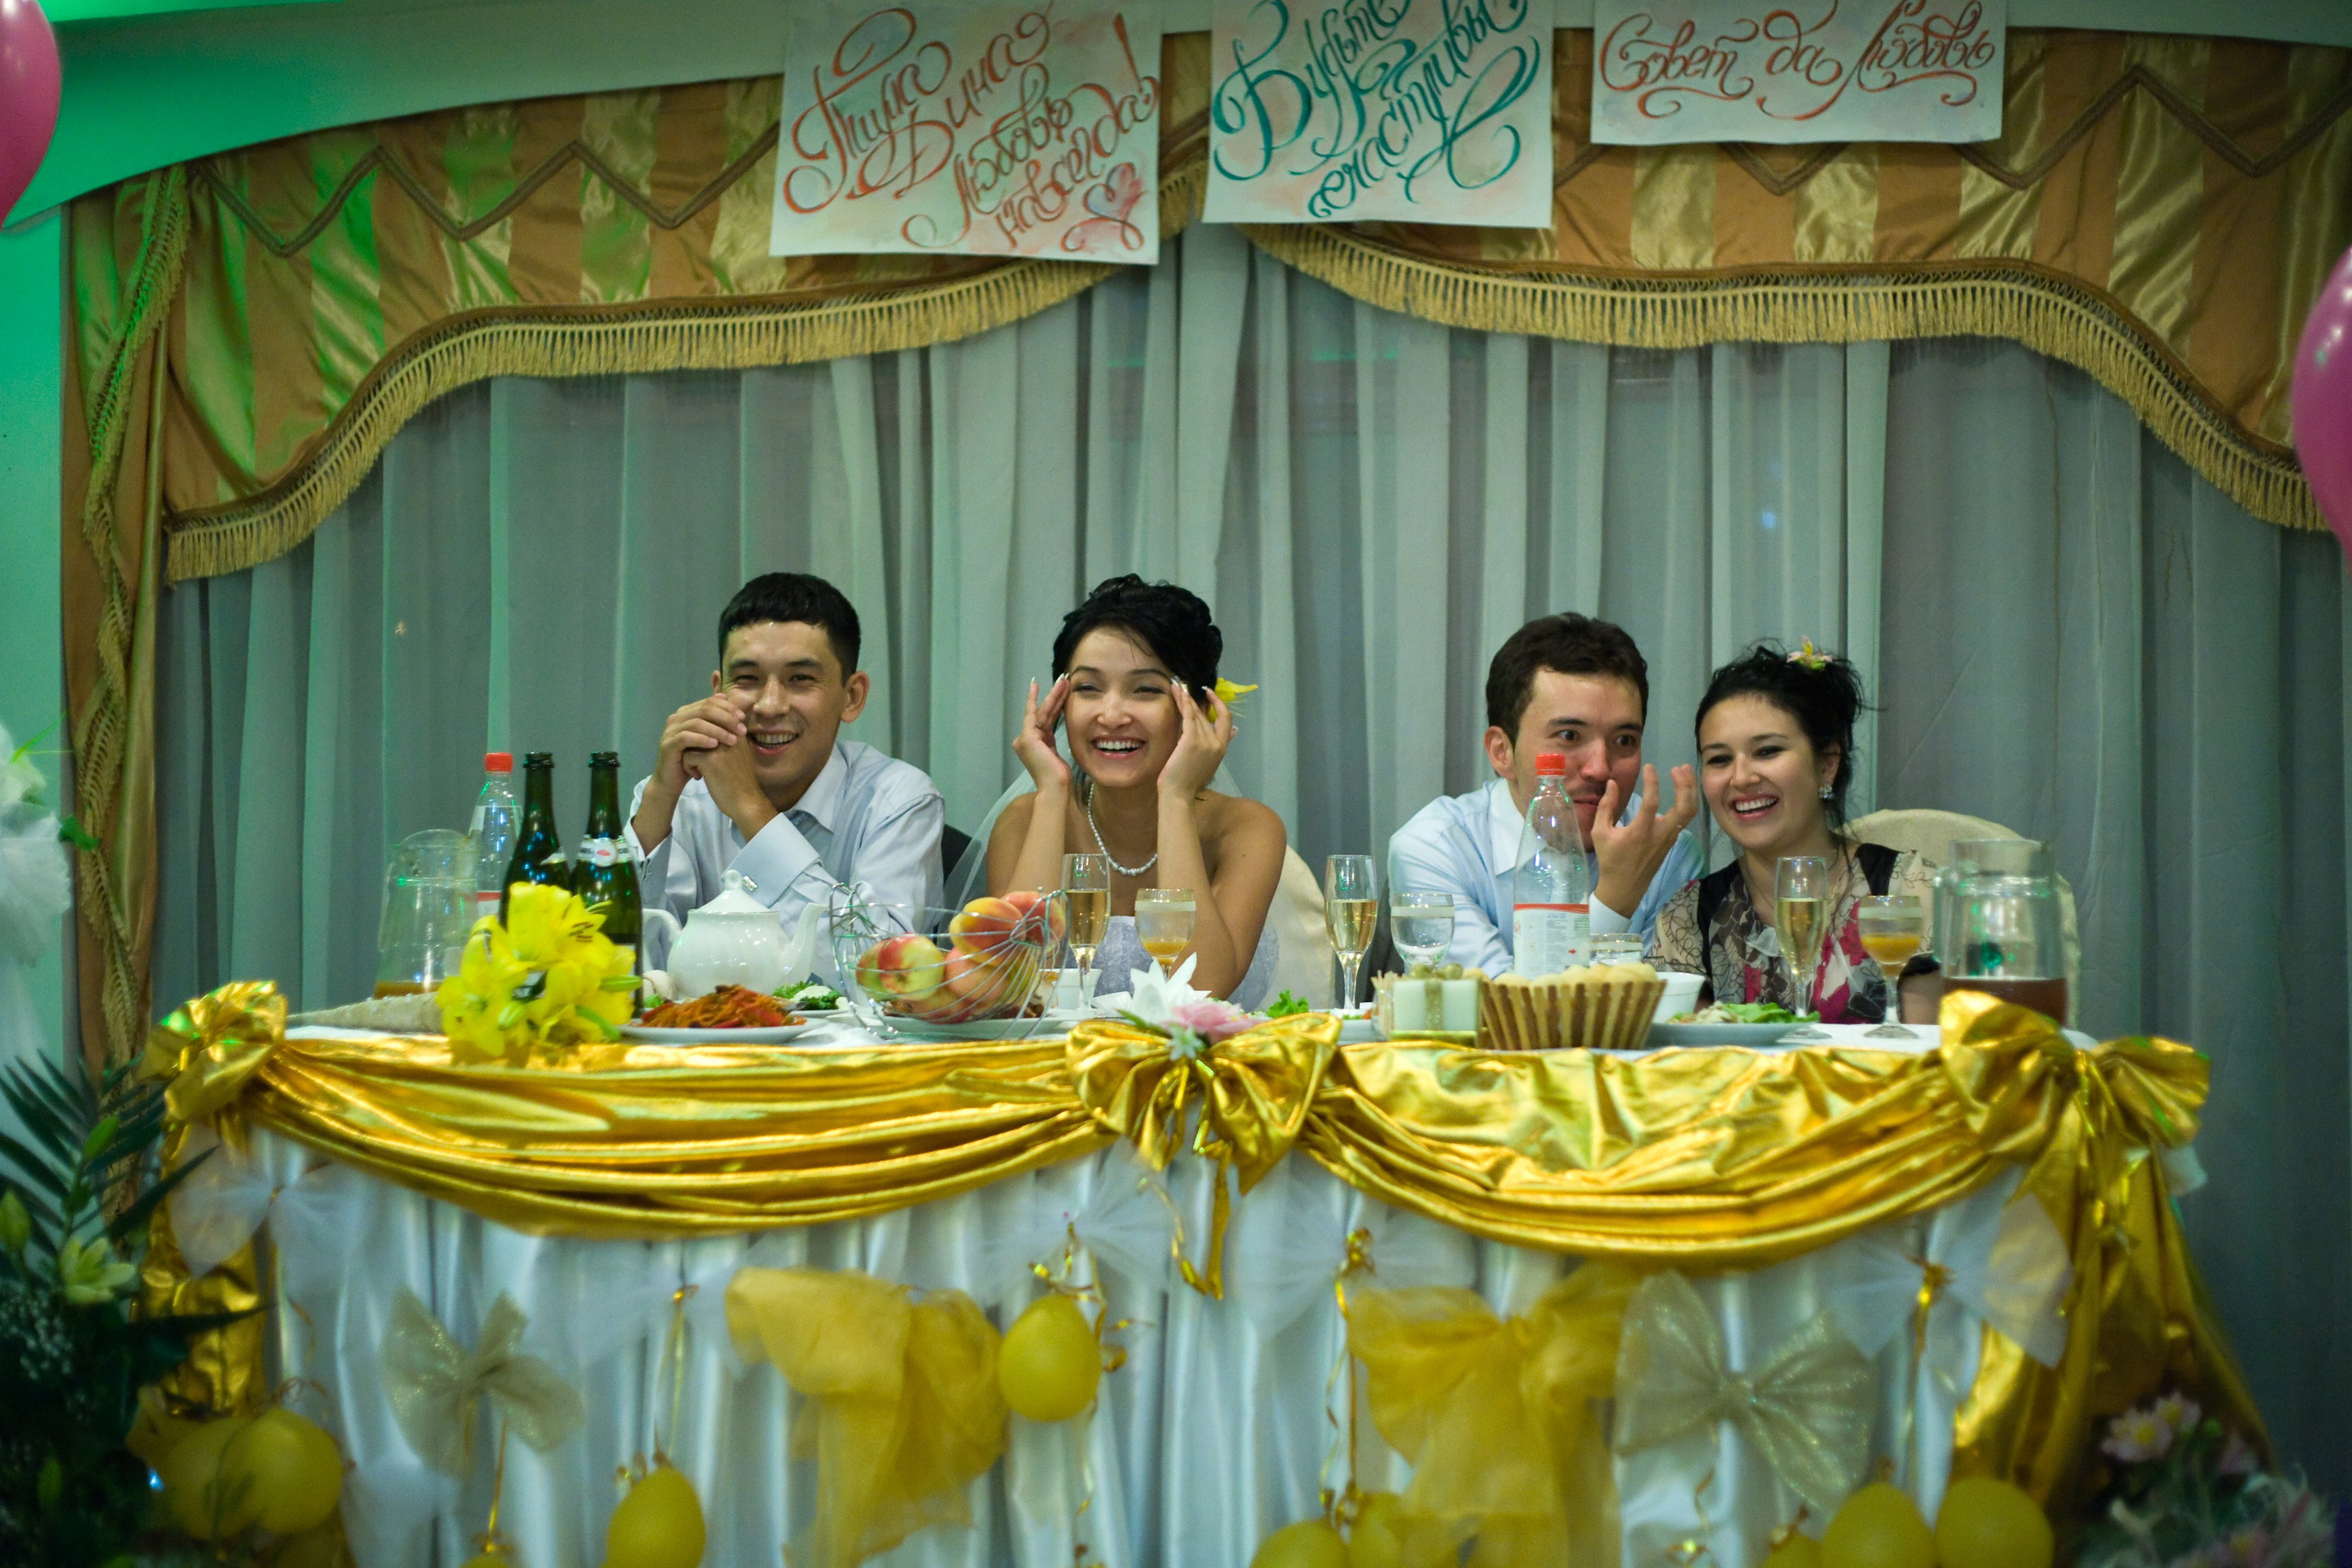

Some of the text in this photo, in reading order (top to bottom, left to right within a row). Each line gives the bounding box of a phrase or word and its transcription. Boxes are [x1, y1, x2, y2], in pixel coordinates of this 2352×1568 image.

[846, 4, 1054, 199] Дина
[1213, 0, 1415, 182] Будьте
[1600, 13, 1758, 118] Совет
[1763, 0, 1843, 85] да
